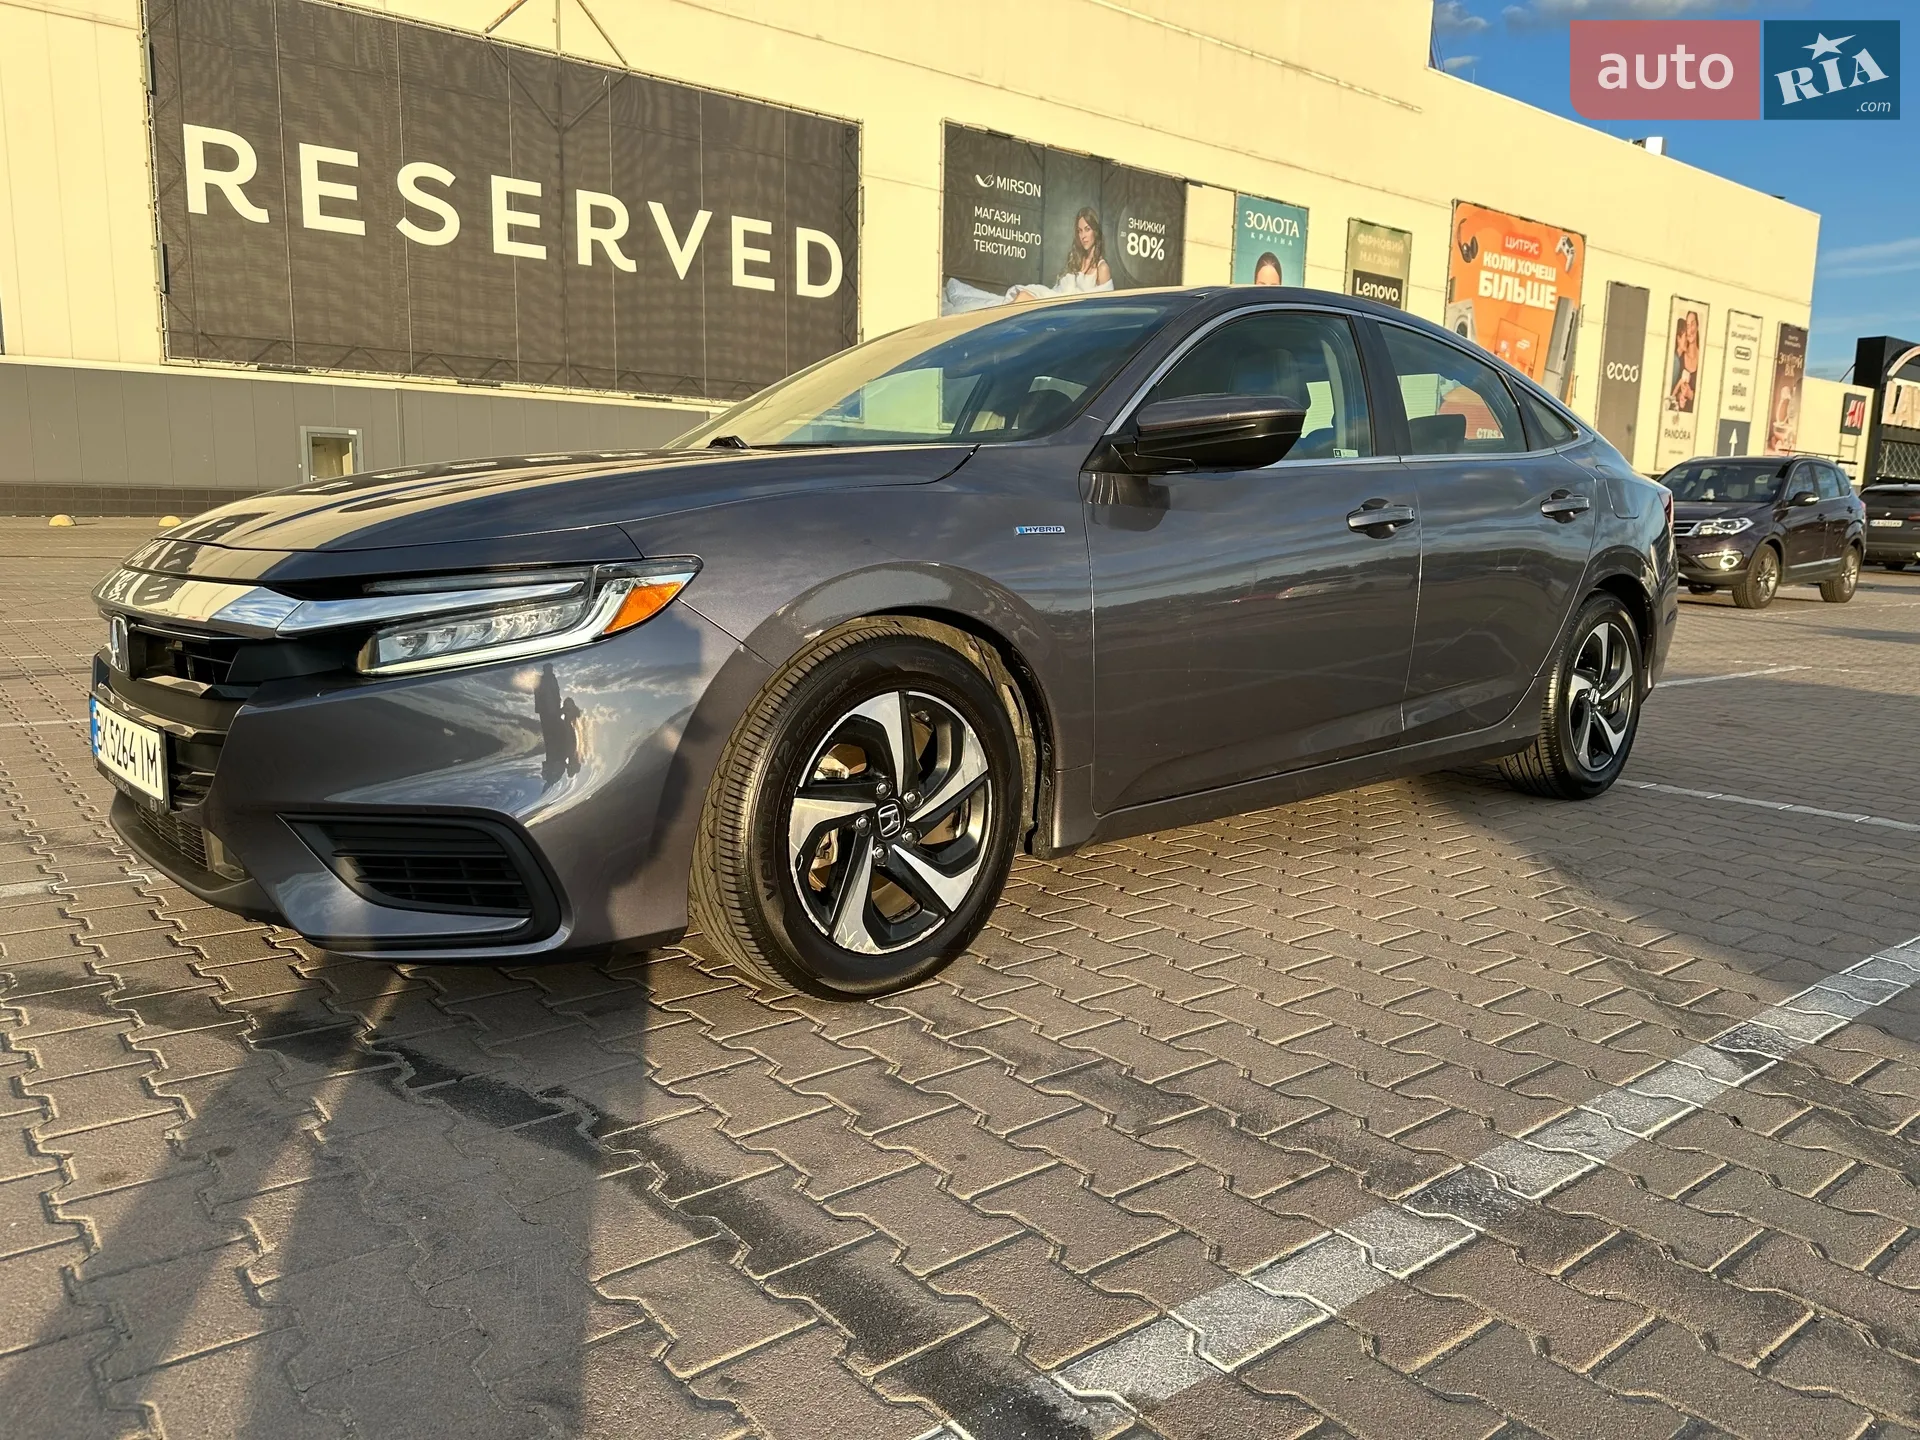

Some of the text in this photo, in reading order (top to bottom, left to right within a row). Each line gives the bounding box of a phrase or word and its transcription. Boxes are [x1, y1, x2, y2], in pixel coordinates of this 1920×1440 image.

[996, 175, 1042, 198] MIRSON
[182, 123, 844, 299] RESERVED
[974, 205, 1021, 226] МАГАЗИН
[973, 222, 1042, 246] ДОМАШНЬОГО
[1128, 217, 1166, 235] ЗНИЖКИ
[1244, 210, 1300, 238] ЗОЛОТА
[973, 239, 1027, 259] ТЕКСТИЛЮ
[1126, 232, 1165, 261] 80%
[1505, 235, 1539, 255] ЦИТРУС
[1483, 250, 1557, 282] КОЛИ ХОЧЕШ
[1355, 277, 1399, 302] Lenovo
[1478, 269, 1557, 311] БІЛЬШЕ
[1606, 361, 1639, 383] ecco
[110, 718, 137, 777] 5264
[140, 734, 158, 789] IM
